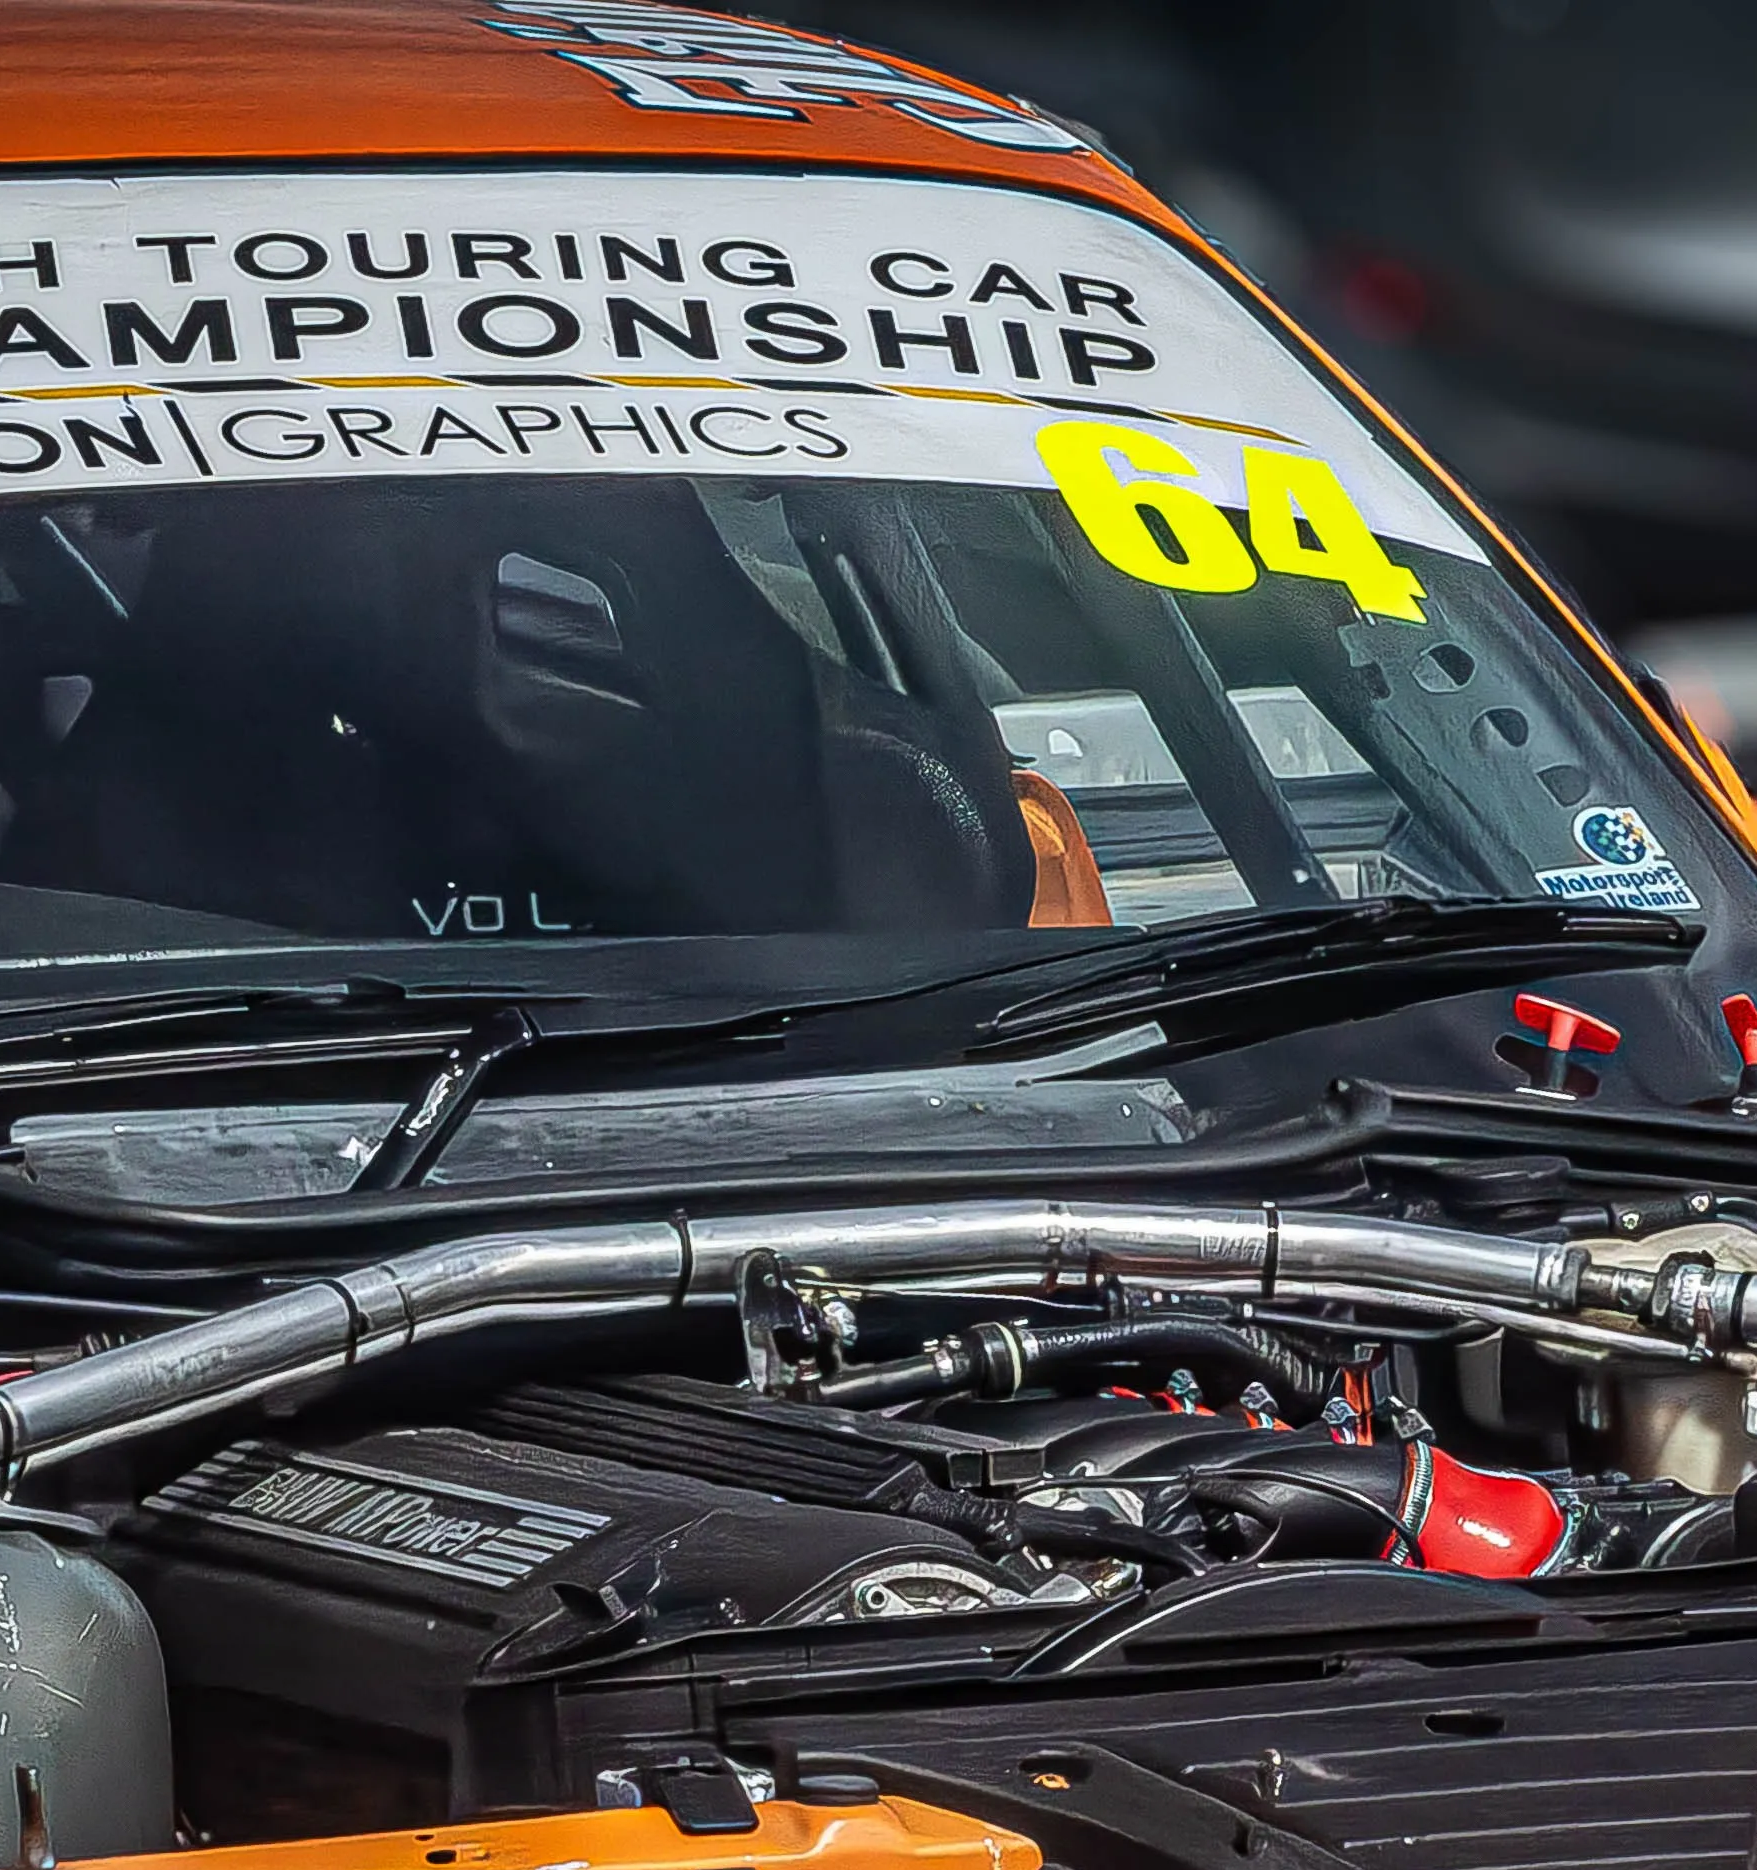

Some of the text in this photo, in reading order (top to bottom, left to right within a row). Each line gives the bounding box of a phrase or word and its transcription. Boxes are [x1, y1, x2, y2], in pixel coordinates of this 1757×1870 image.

[136, 230, 797, 292] TOURING
[869, 251, 1146, 328] CAR
[218, 403, 850, 466] GRAPHICS
[1035, 420, 1428, 624] 64
[1542, 865, 1676, 896] Motorsport
[1606, 886, 1692, 909] Ireland
